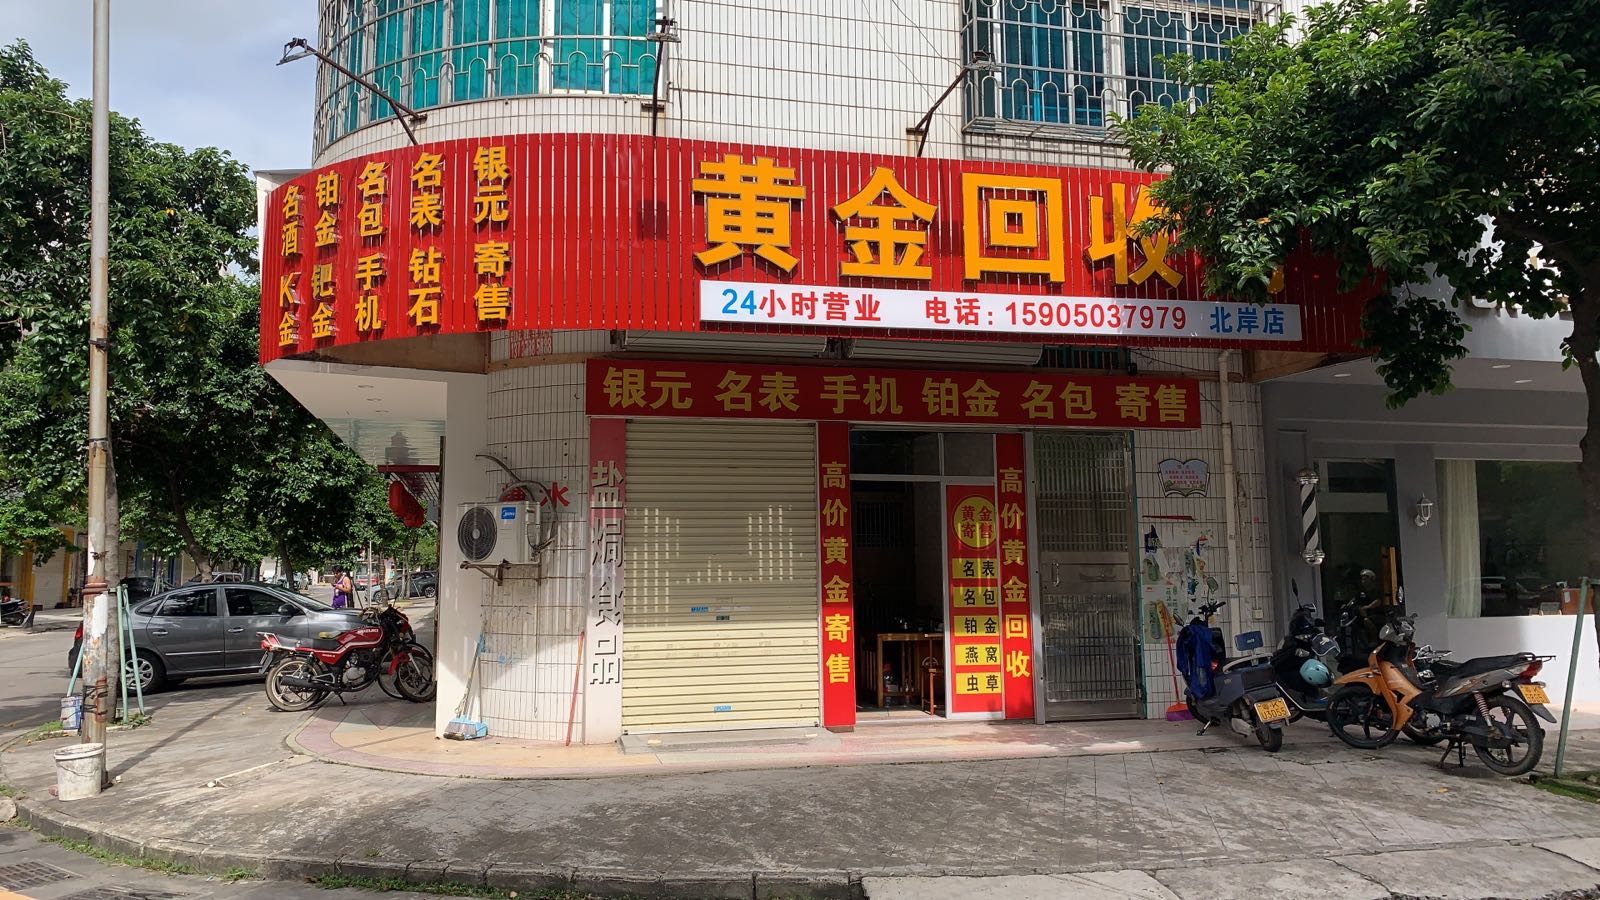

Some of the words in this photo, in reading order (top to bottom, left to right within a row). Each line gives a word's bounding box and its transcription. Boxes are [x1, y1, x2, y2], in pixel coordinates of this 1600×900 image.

[281, 184, 299, 256] 名酒
[315, 170, 338, 247] 铂金
[357, 161, 386, 236] 名包
[410, 152, 443, 228] 名表
[474, 146, 508, 223] 银元
[692, 154, 1285, 294] 黄金回收
[279, 272, 300, 347] K金
[311, 263, 334, 339] 钯金
[354, 252, 384, 331] 手机
[408, 246, 443, 326] 钻石
[474, 240, 509, 321] 寄售
[722, 288, 882, 322] 24小时营业
[1210, 306, 1284, 335] 北岸店
[603, 367, 693, 409] 银元
[715, 370, 800, 412] 名表
[820, 375, 904, 415] 手机
[922, 377, 1000, 417] 铂金
[1021, 381, 1097, 419] 名包
[1115, 383, 1187, 422] 寄售
[961, 505, 993, 522] 黄金
[961, 522, 993, 540] 寄售
[822, 461, 851, 684] 高价黄金寄售
[963, 560, 995, 577] 名表
[964, 588, 996, 606] 名包
[1000, 467, 1030, 678] 高价黄金回收
[965, 617, 997, 634] 铂金
[965, 646, 997, 663] 燕窝
[966, 675, 999, 692] 虫草
